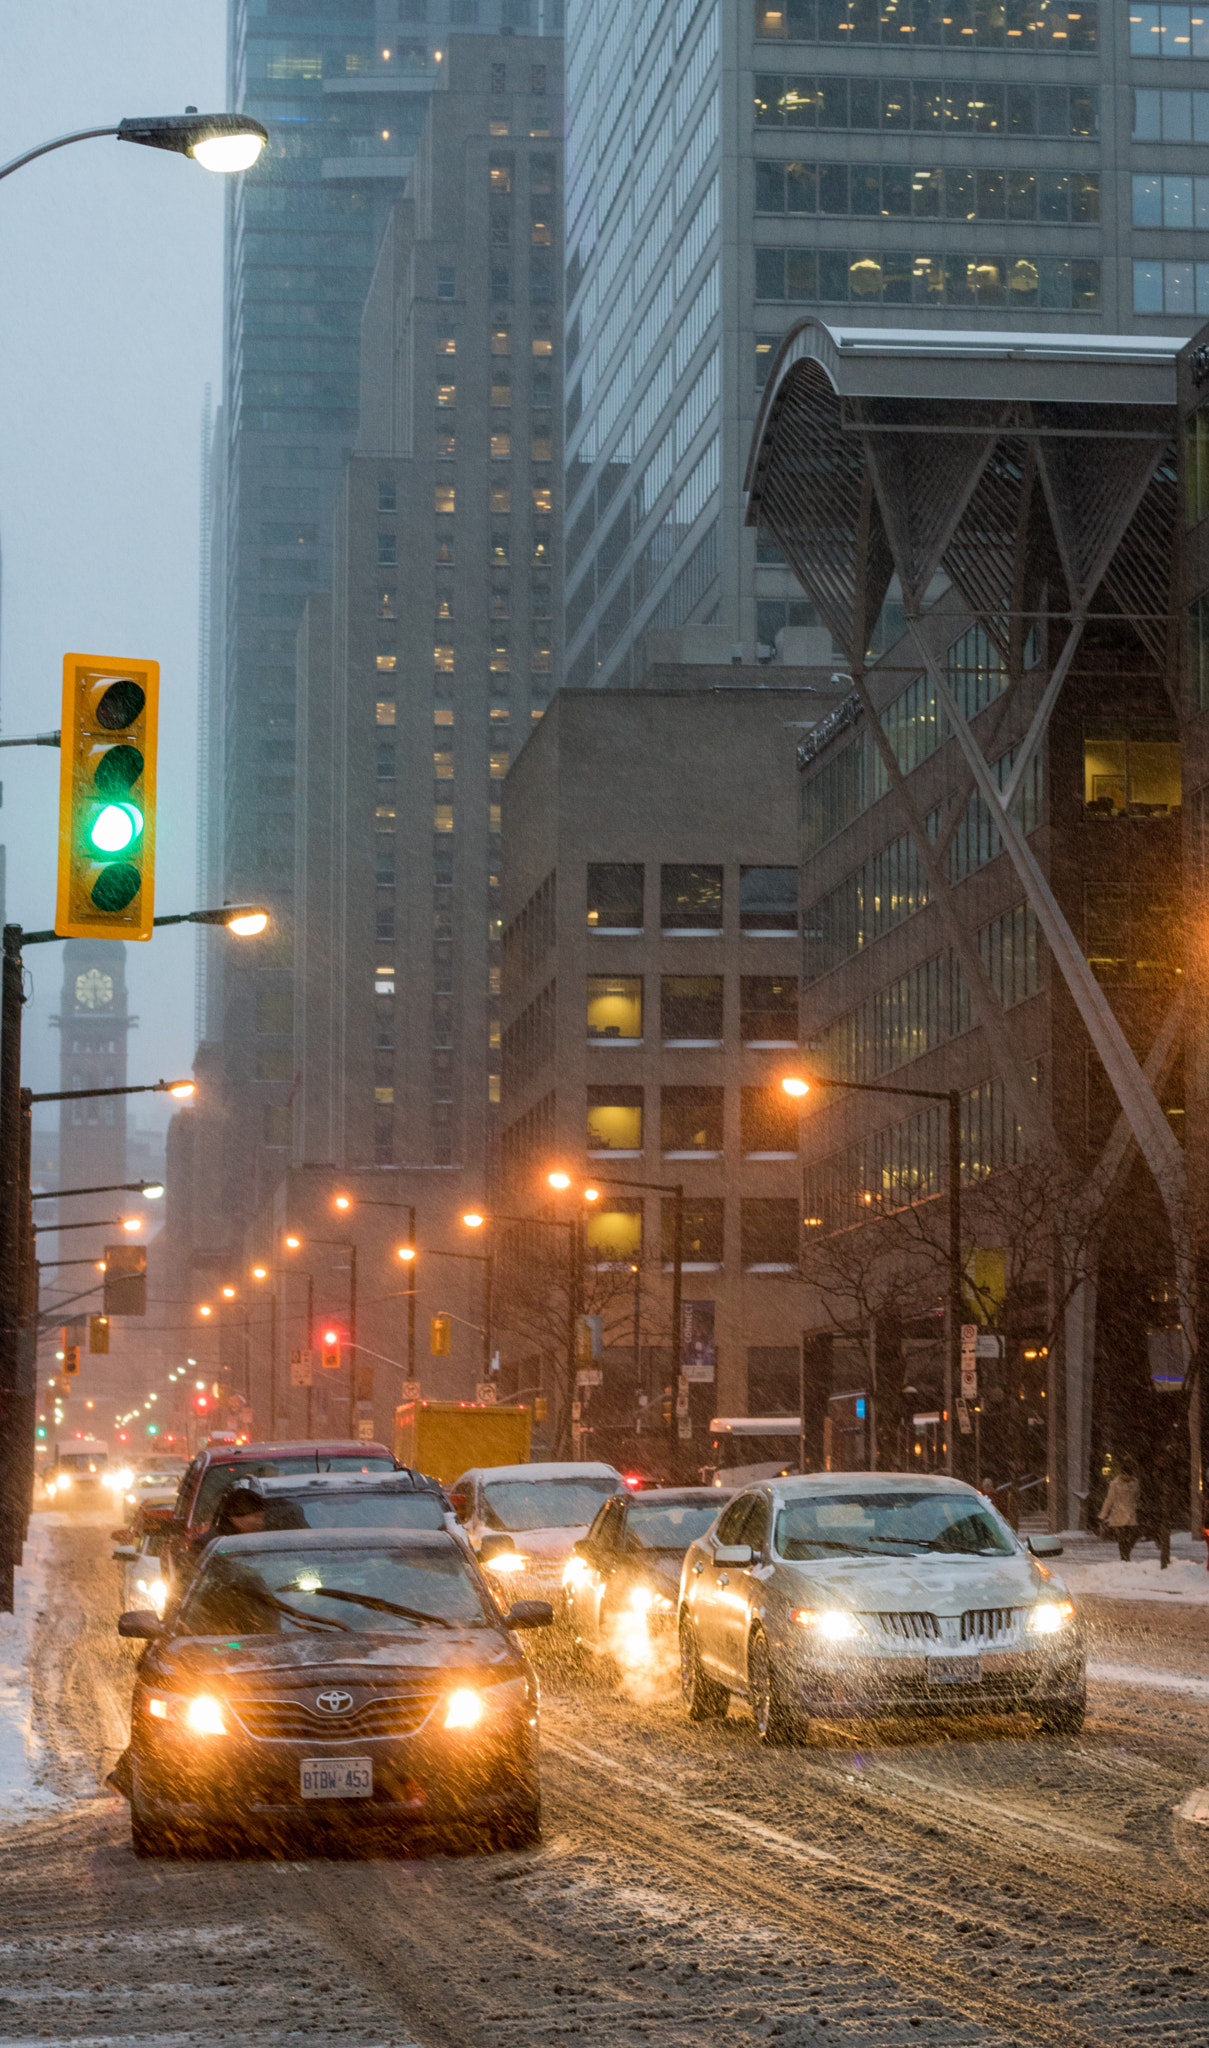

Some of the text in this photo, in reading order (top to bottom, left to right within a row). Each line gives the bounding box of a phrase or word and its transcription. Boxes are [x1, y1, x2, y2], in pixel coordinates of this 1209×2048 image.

[684, 1303, 693, 1343] CONNECT
[359, 1427, 373, 1437] 40
[304, 1770, 369, 1789] BTBW 453
